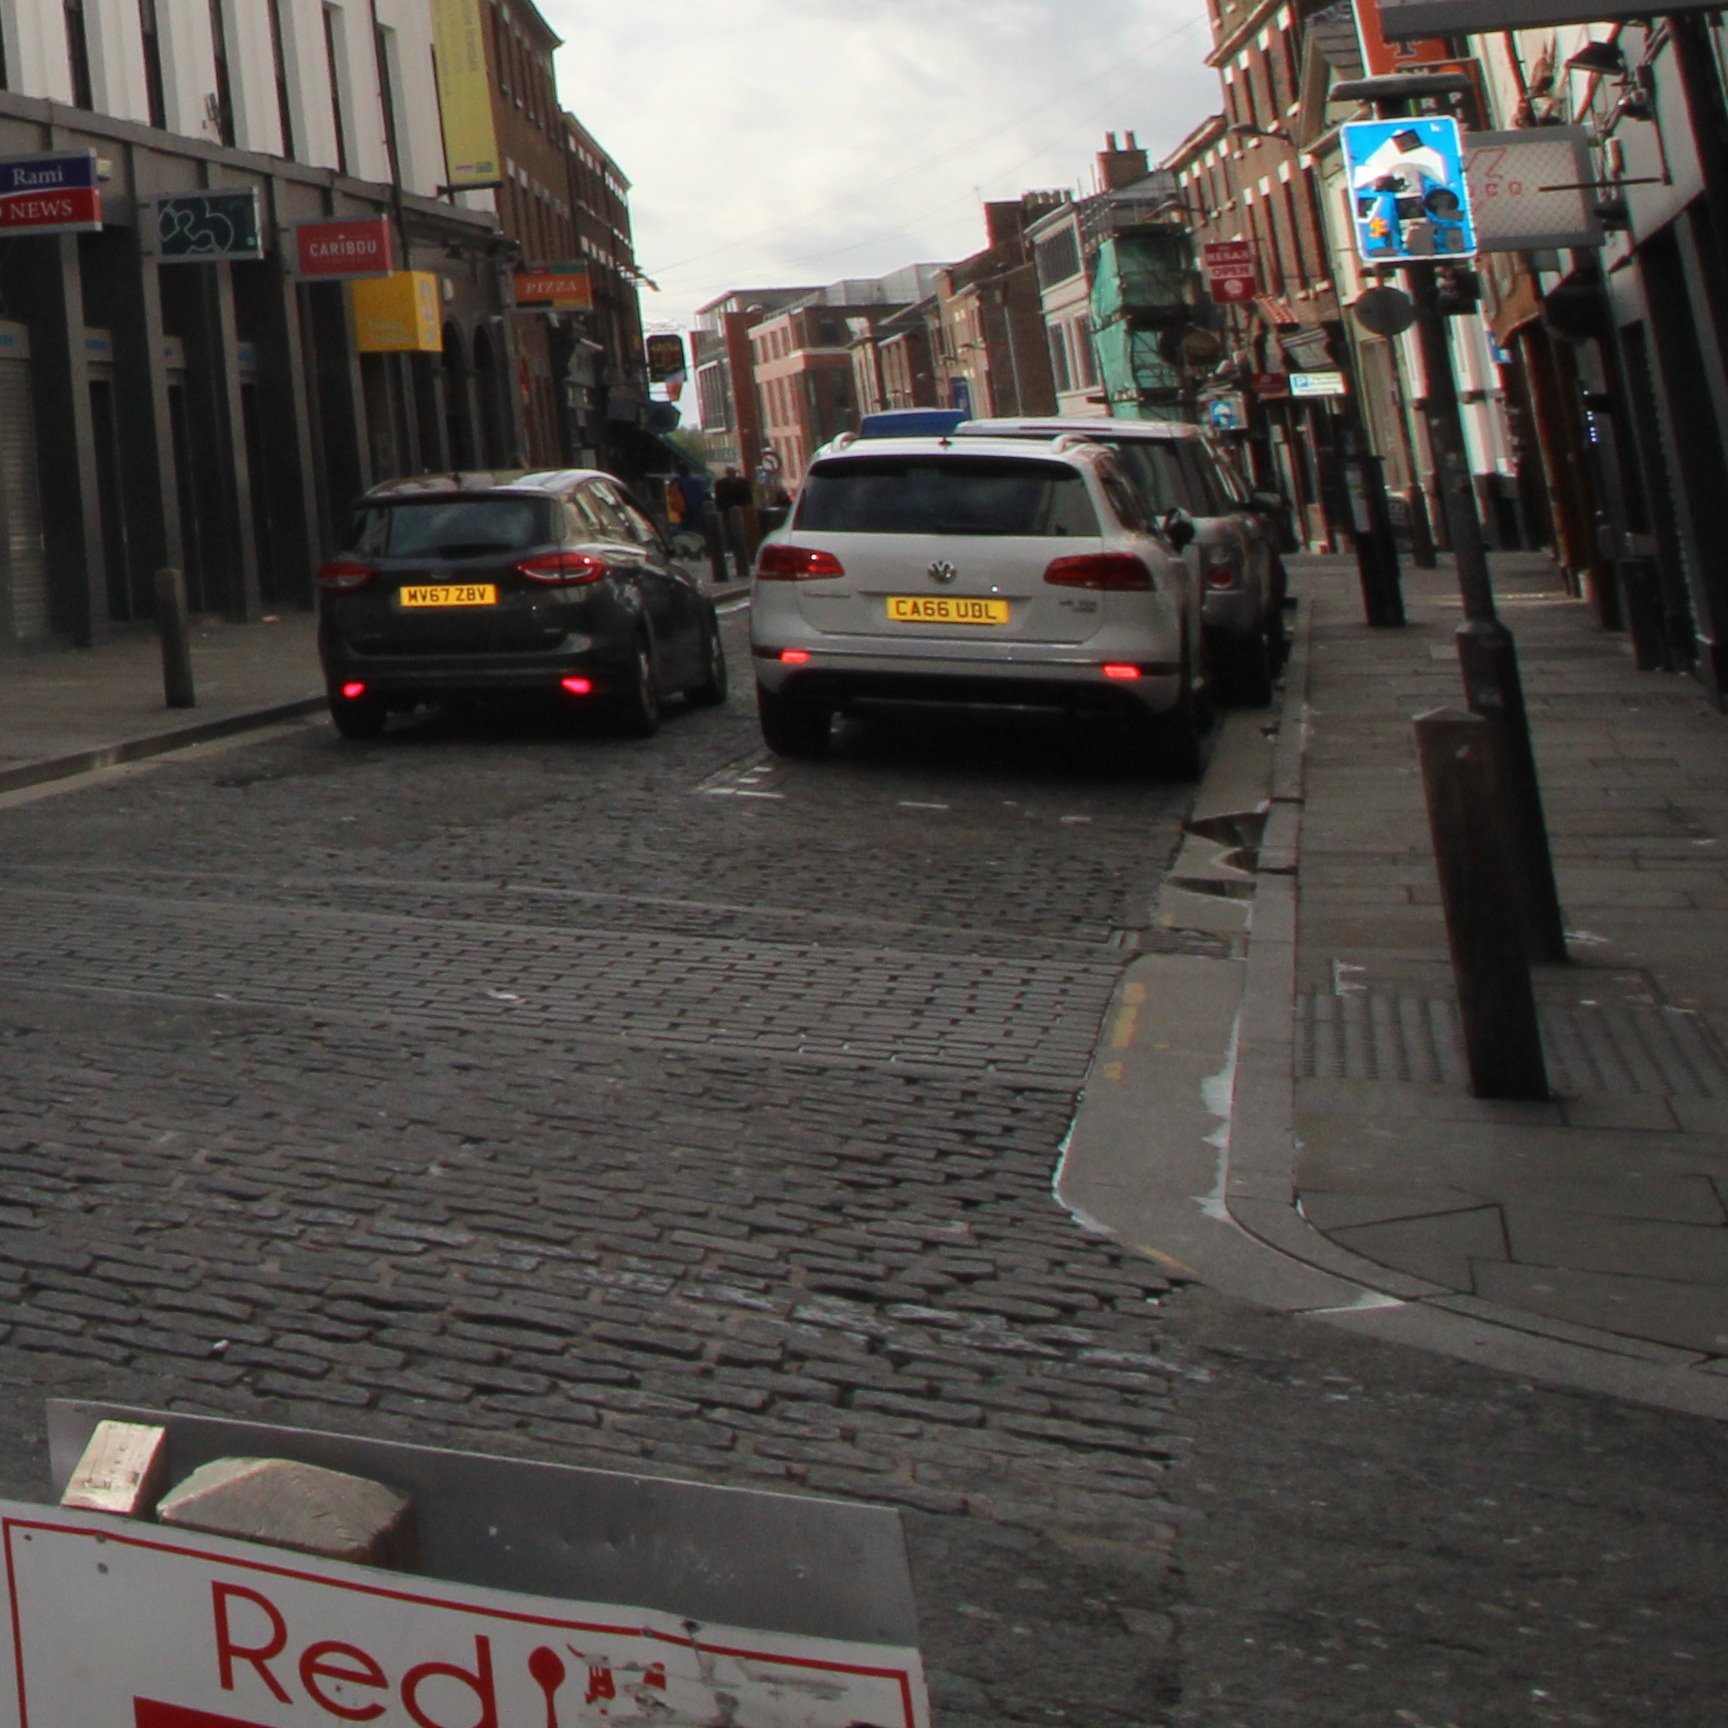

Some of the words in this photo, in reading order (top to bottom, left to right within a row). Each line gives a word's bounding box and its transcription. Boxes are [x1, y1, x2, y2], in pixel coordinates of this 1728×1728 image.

[13, 165, 64, 186] Rami
[10, 199, 73, 220] NEWS
[309, 239, 377, 257] CARIBOU
[526, 279, 578, 295] PIZZA
[408, 587, 450, 603] MV67
[455, 587, 486, 602] ZBV
[895, 599, 950, 618] CA66
[956, 601, 998, 620] UBL
[211, 1580, 497, 1728] Red
